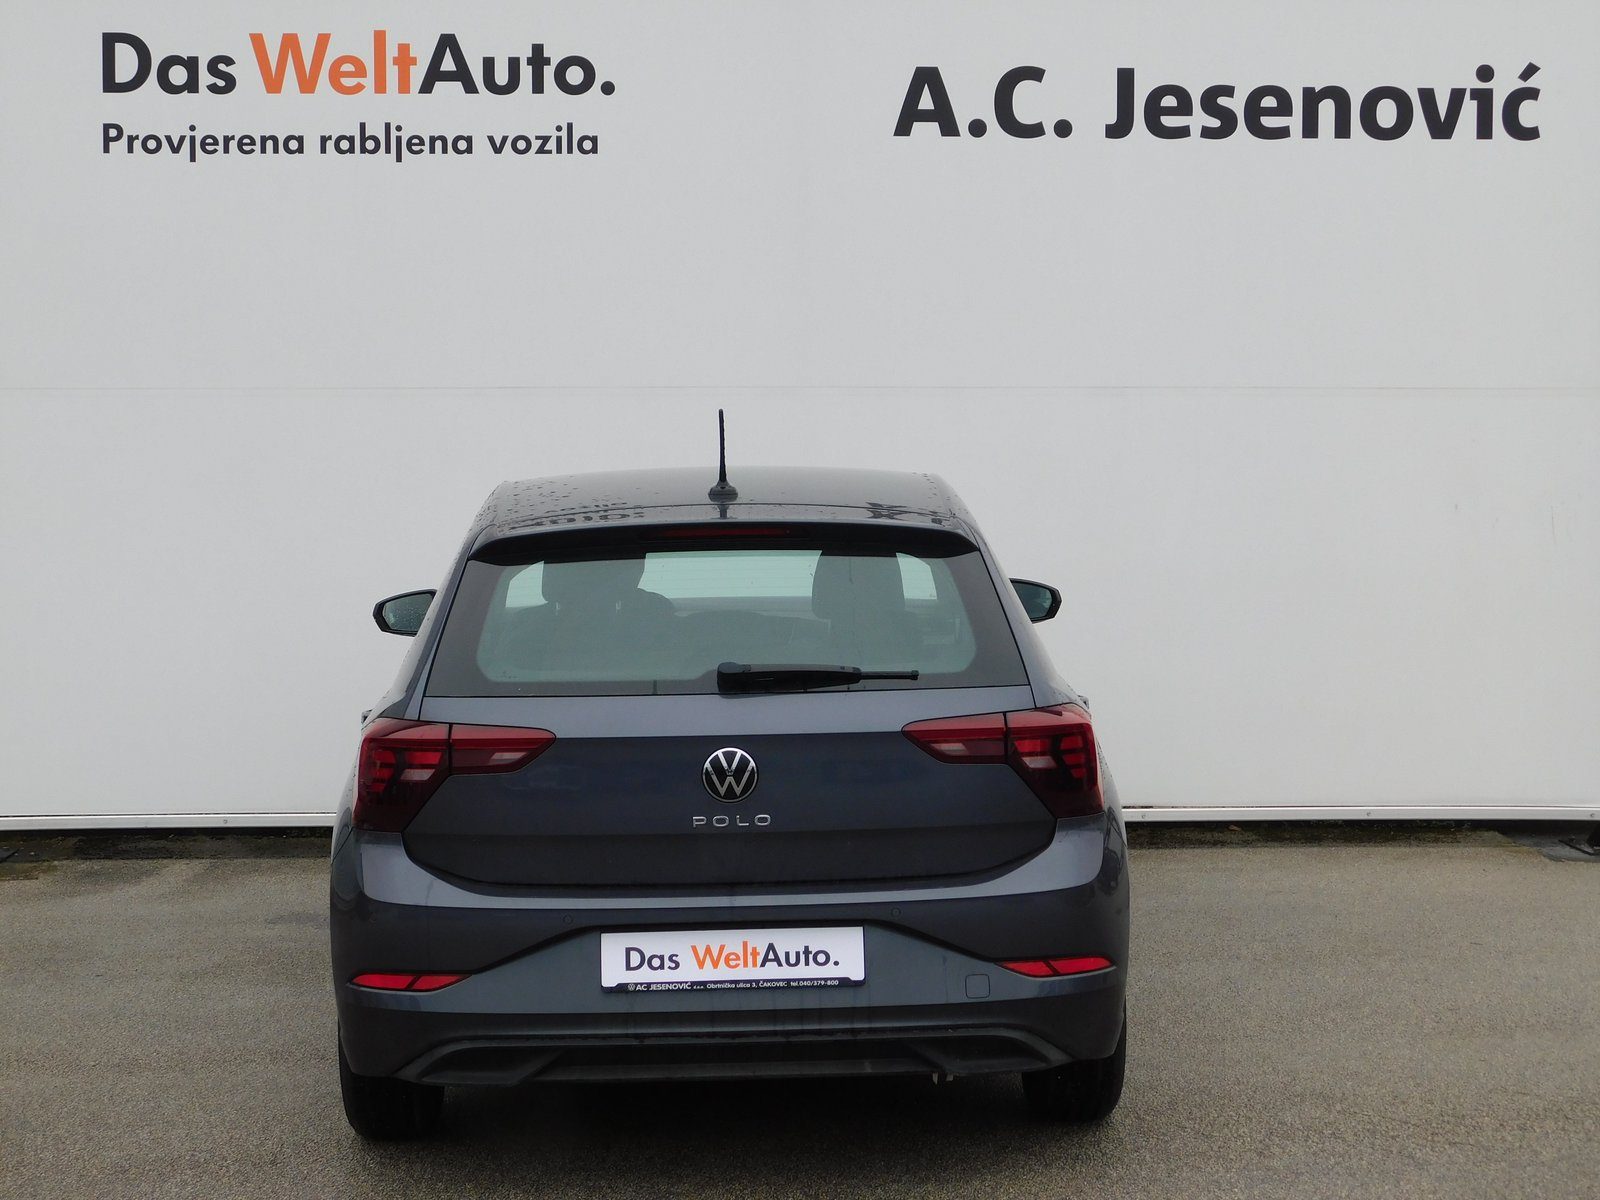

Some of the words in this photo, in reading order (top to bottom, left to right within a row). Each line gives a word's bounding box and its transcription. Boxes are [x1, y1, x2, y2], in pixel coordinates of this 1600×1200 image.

[102, 32, 236, 95] Das
[249, 30, 616, 95] WeltAuto.
[893, 66, 1073, 138] A.C.
[1105, 62, 1541, 141] Jesenović
[102, 123, 305, 163] Provjerena
[319, 122, 473, 163] rabljena
[487, 122, 599, 156] vozila
[692, 814, 771, 828] POLO
[624, 947, 681, 972] Das
[690, 940, 840, 970] WeltAuto.
[635, 983, 648, 991] AC
[649, 981, 692, 991] JESENOVIĆ
